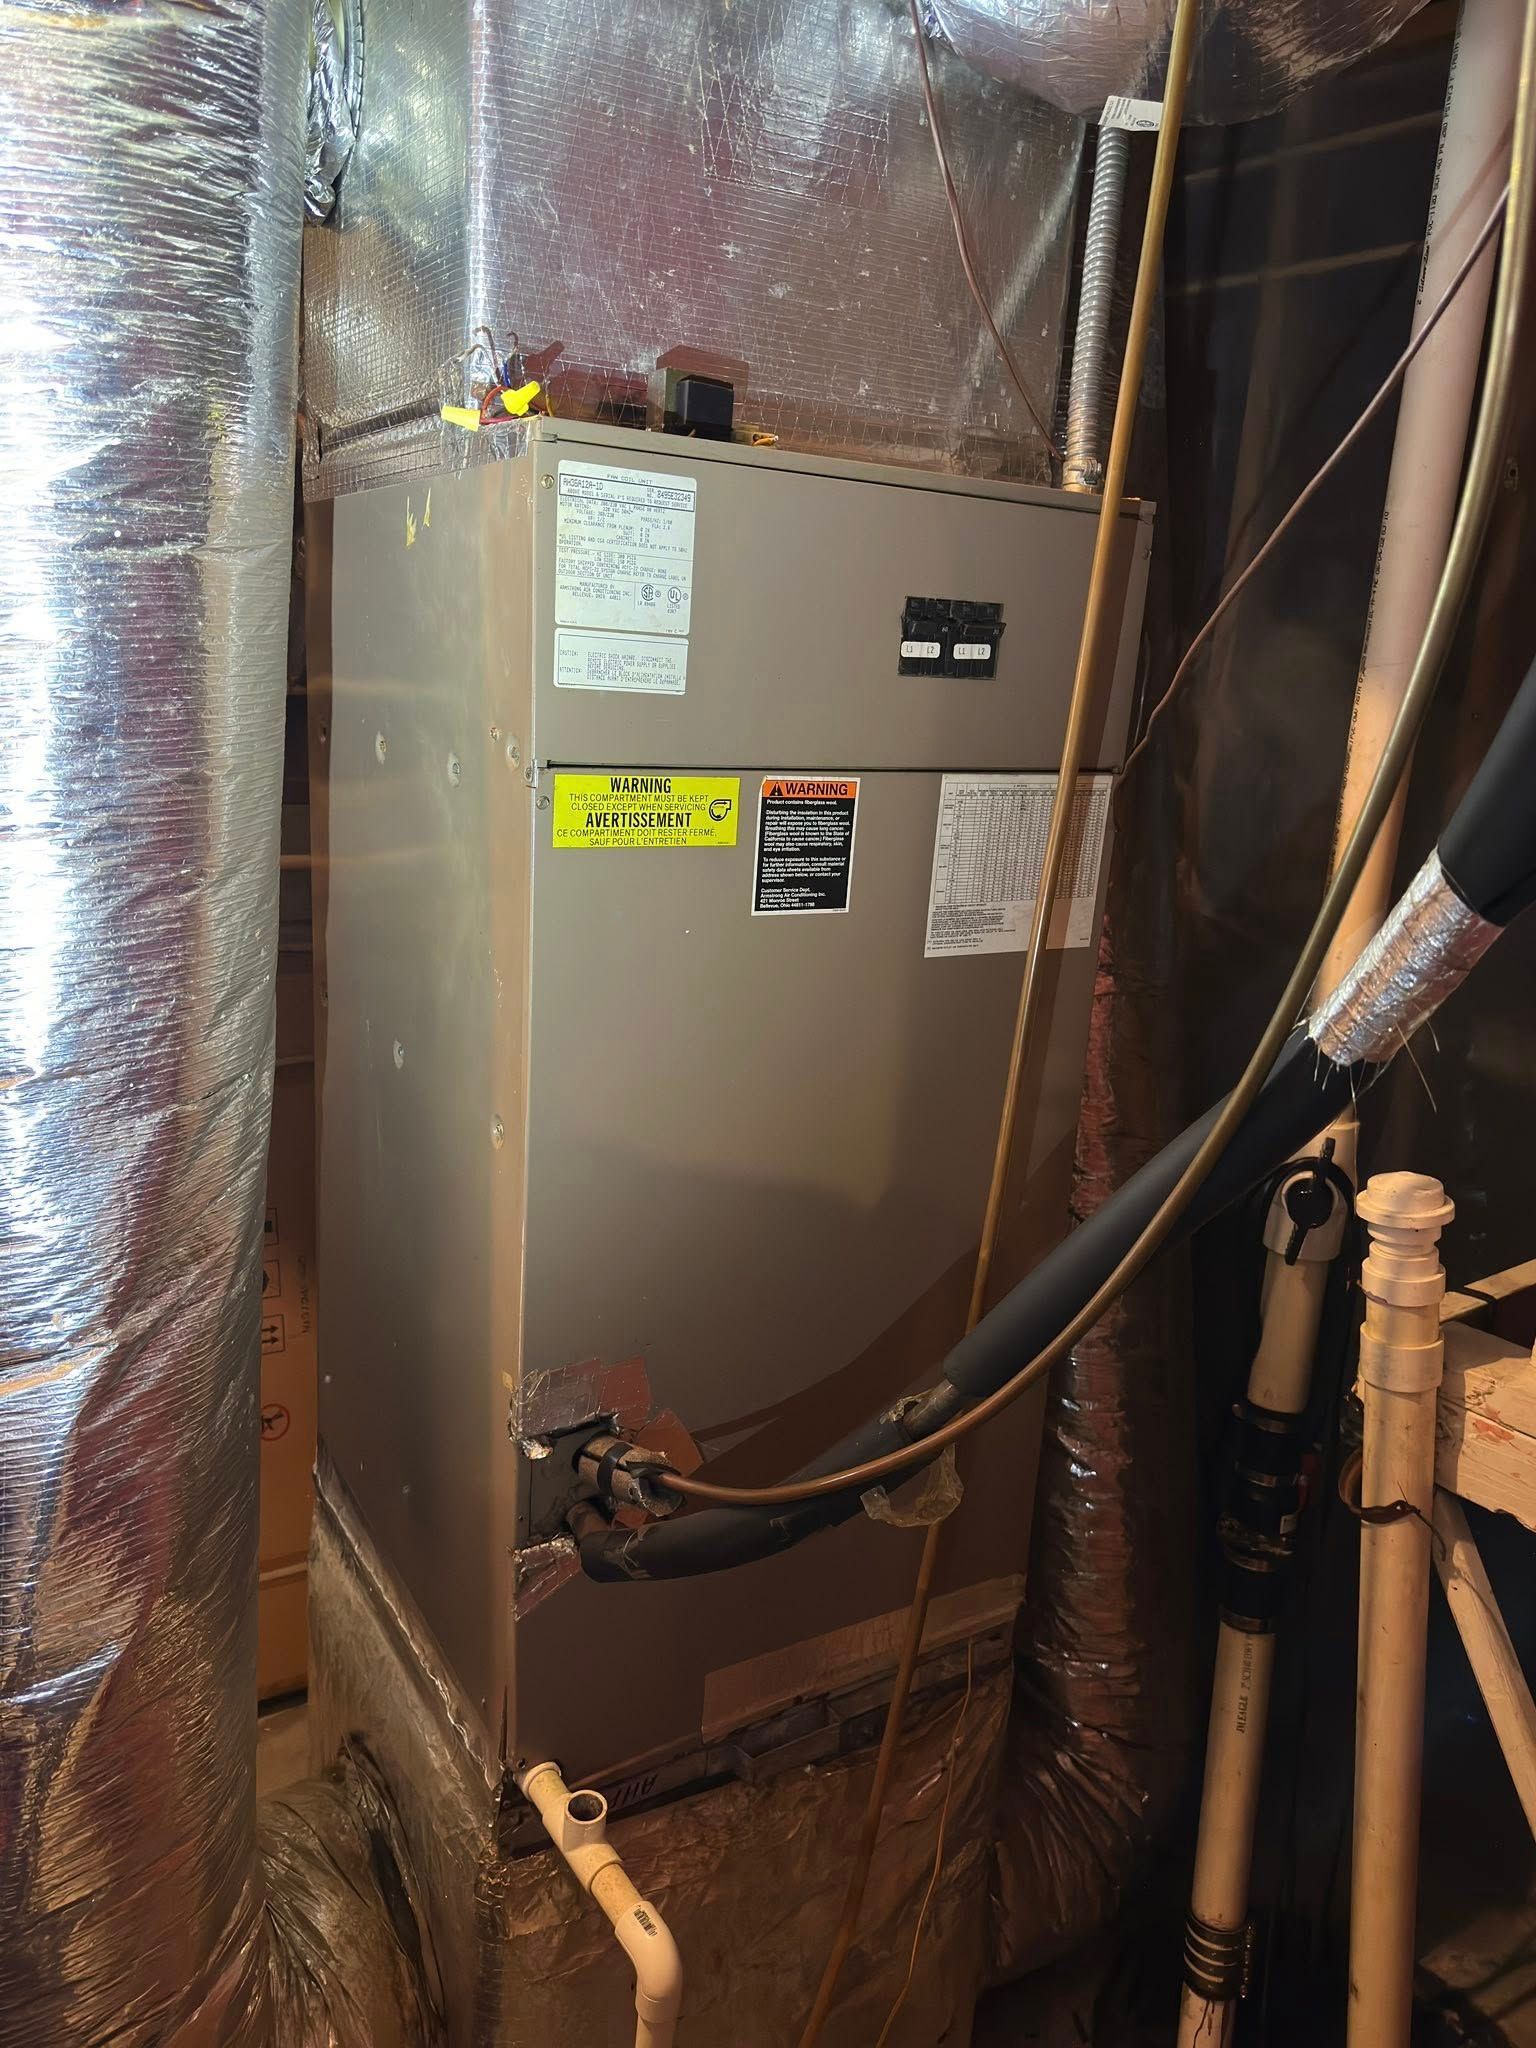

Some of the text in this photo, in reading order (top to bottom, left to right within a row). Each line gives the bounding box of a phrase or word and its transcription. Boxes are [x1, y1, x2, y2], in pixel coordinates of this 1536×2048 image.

[906, 645, 913, 653] L1
[958, 647, 986, 656] L1 L2
[609, 777, 671, 792] WARNING
[785, 783, 848, 795] WARNING
[569, 793, 708, 802] THIS COMPARTMENT MUST BE KEPT
[571, 802, 604, 810] CLOSED
[606, 802, 637, 810] EXCEPT
[664, 803, 705, 811] SERVICING
[585, 812, 692, 827] AVERTISSEMENT
[556, 829, 567, 837] CE
[569, 829, 635, 837] COMPARTIMENT
[637, 828, 655, 836] DOIT
[657, 828, 687, 836] RESTER
[636, 837, 686, 845] L'ENTRETIEN
[1237, 1695, 1248, 1723] EAGLE
